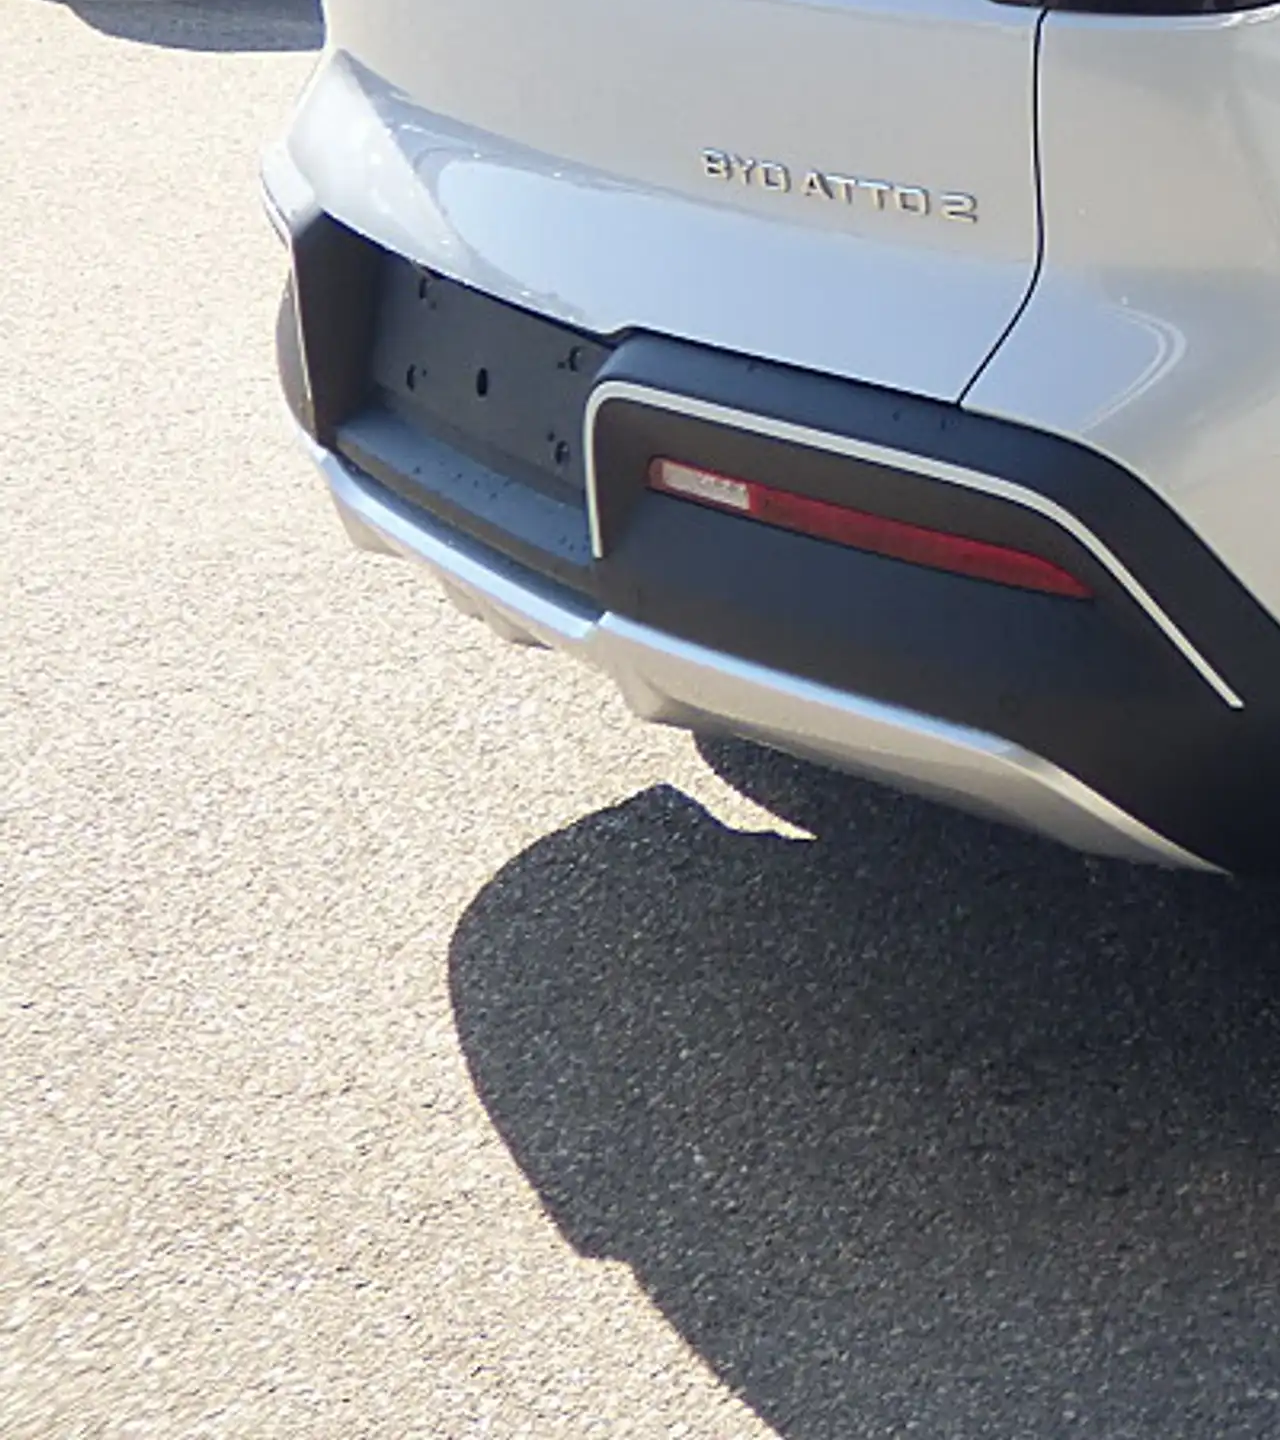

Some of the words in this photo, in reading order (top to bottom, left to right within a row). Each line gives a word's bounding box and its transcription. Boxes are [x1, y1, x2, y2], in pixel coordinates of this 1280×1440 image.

[701, 146, 791, 193] BYD
[800, 167, 930, 216] ATTO
[939, 191, 978, 224] 2
